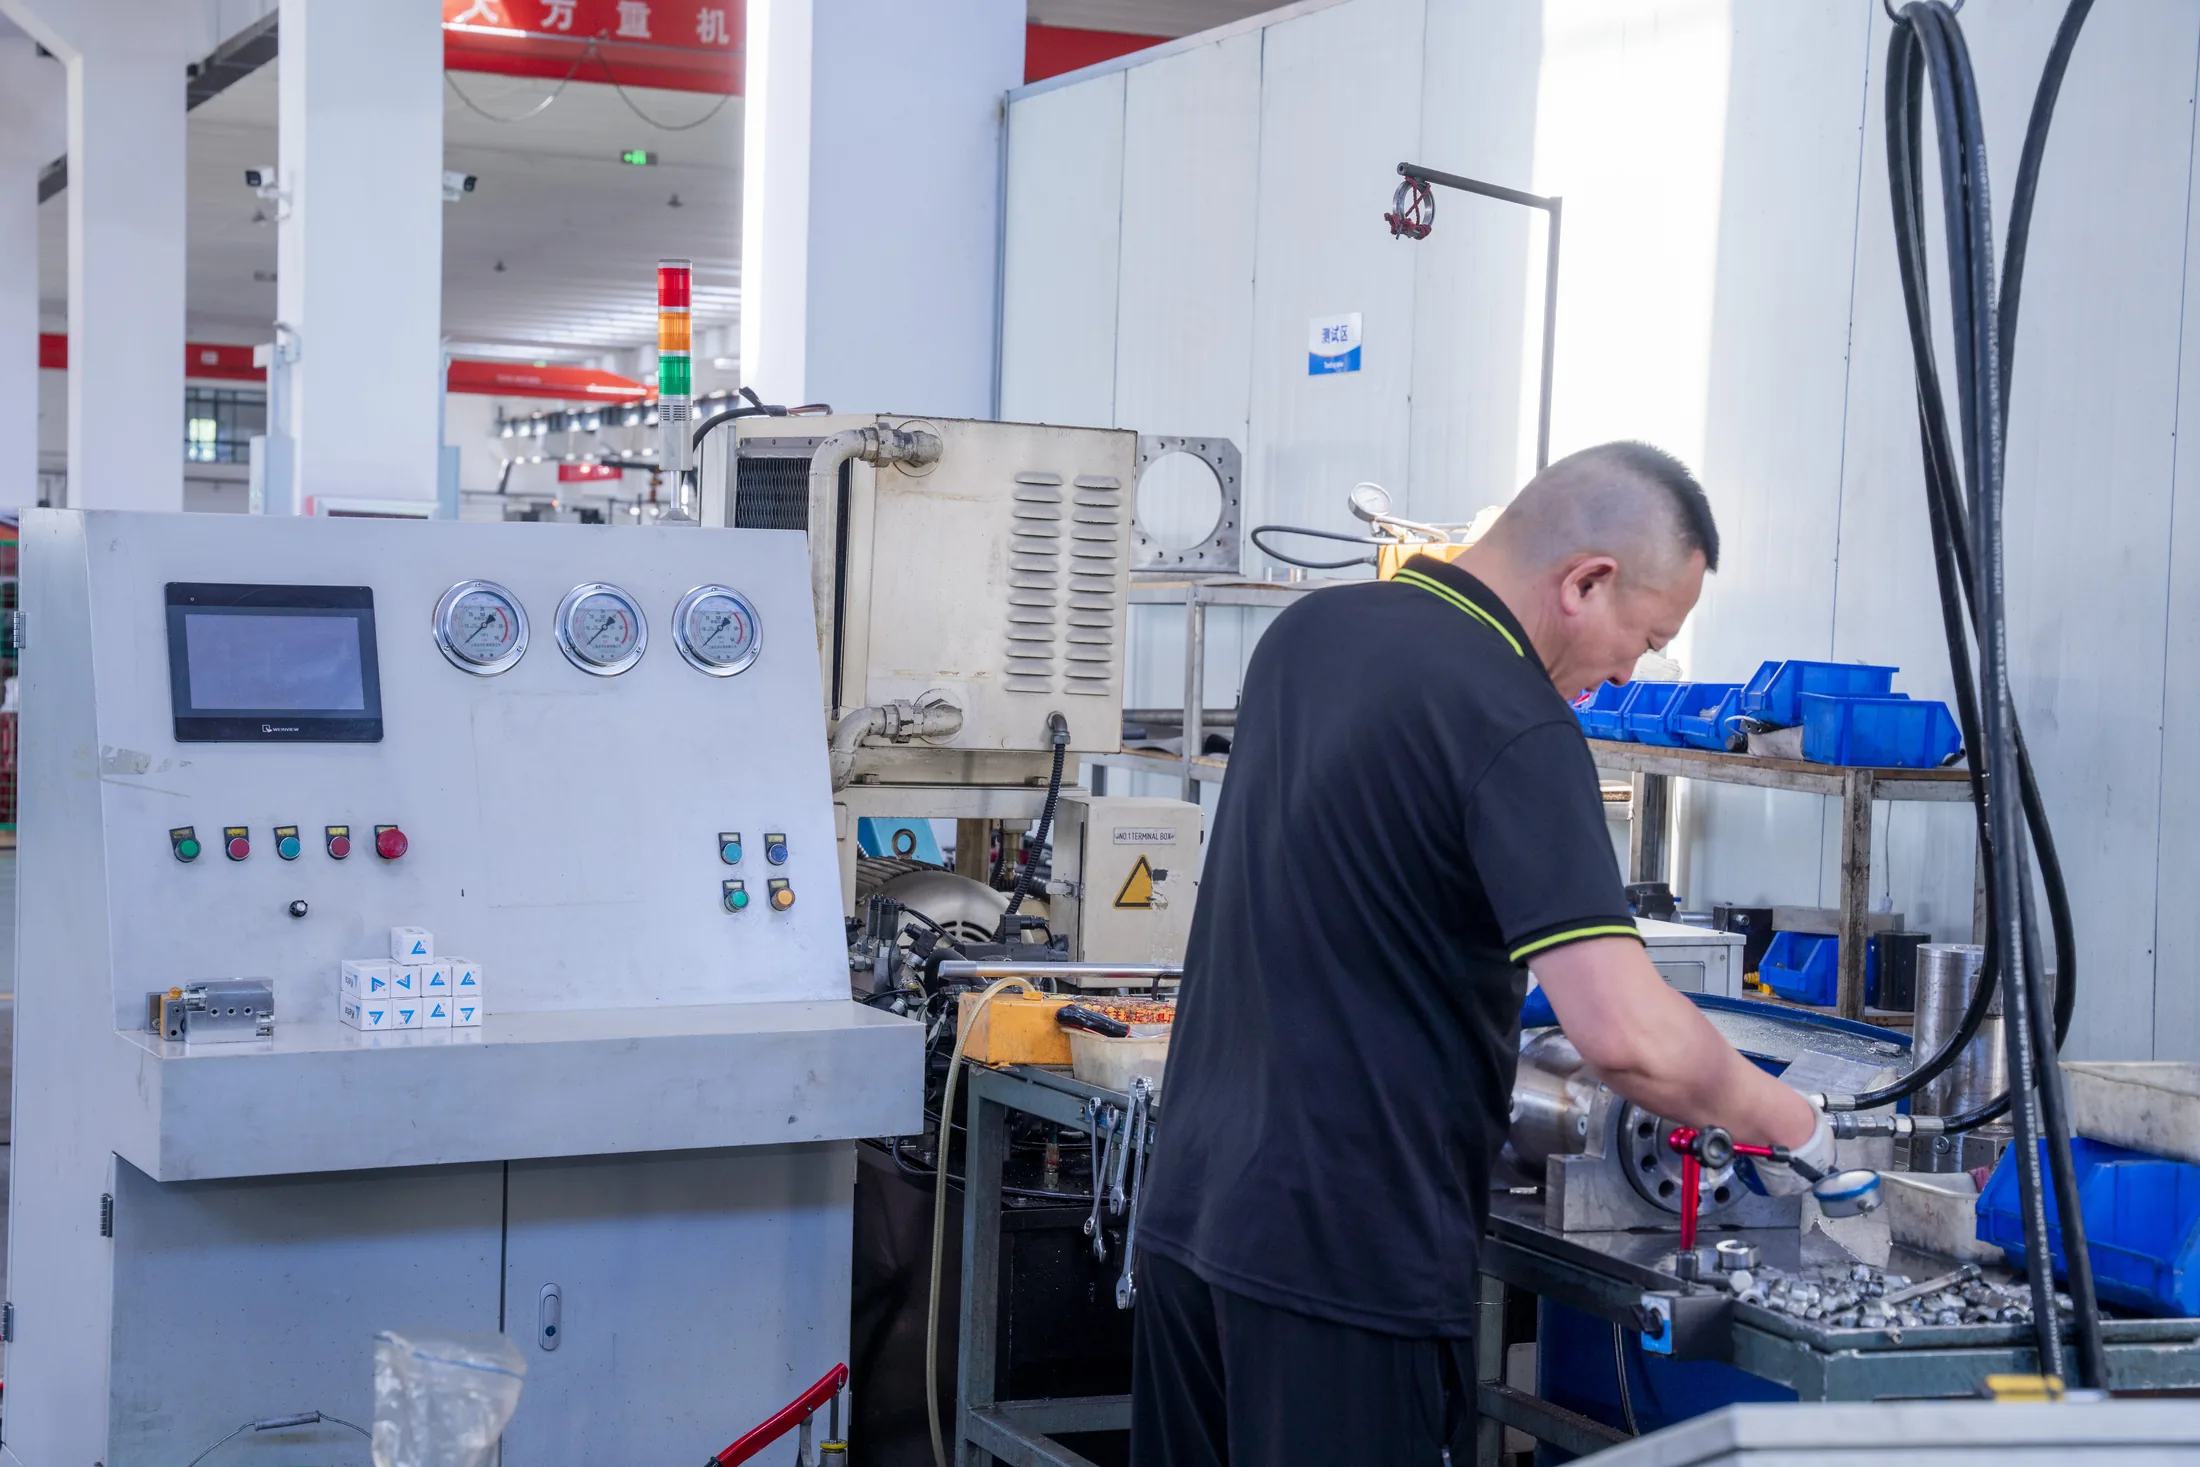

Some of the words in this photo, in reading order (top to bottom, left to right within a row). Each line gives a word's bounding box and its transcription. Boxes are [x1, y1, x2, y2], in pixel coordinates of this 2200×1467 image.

[1132, 832, 1158, 840] TERMINAL
[1160, 832, 1171, 840] BOX
[2042, 1267, 2054, 1300] HOSE
[2047, 1307, 2063, 1375] HYDRAULIC
